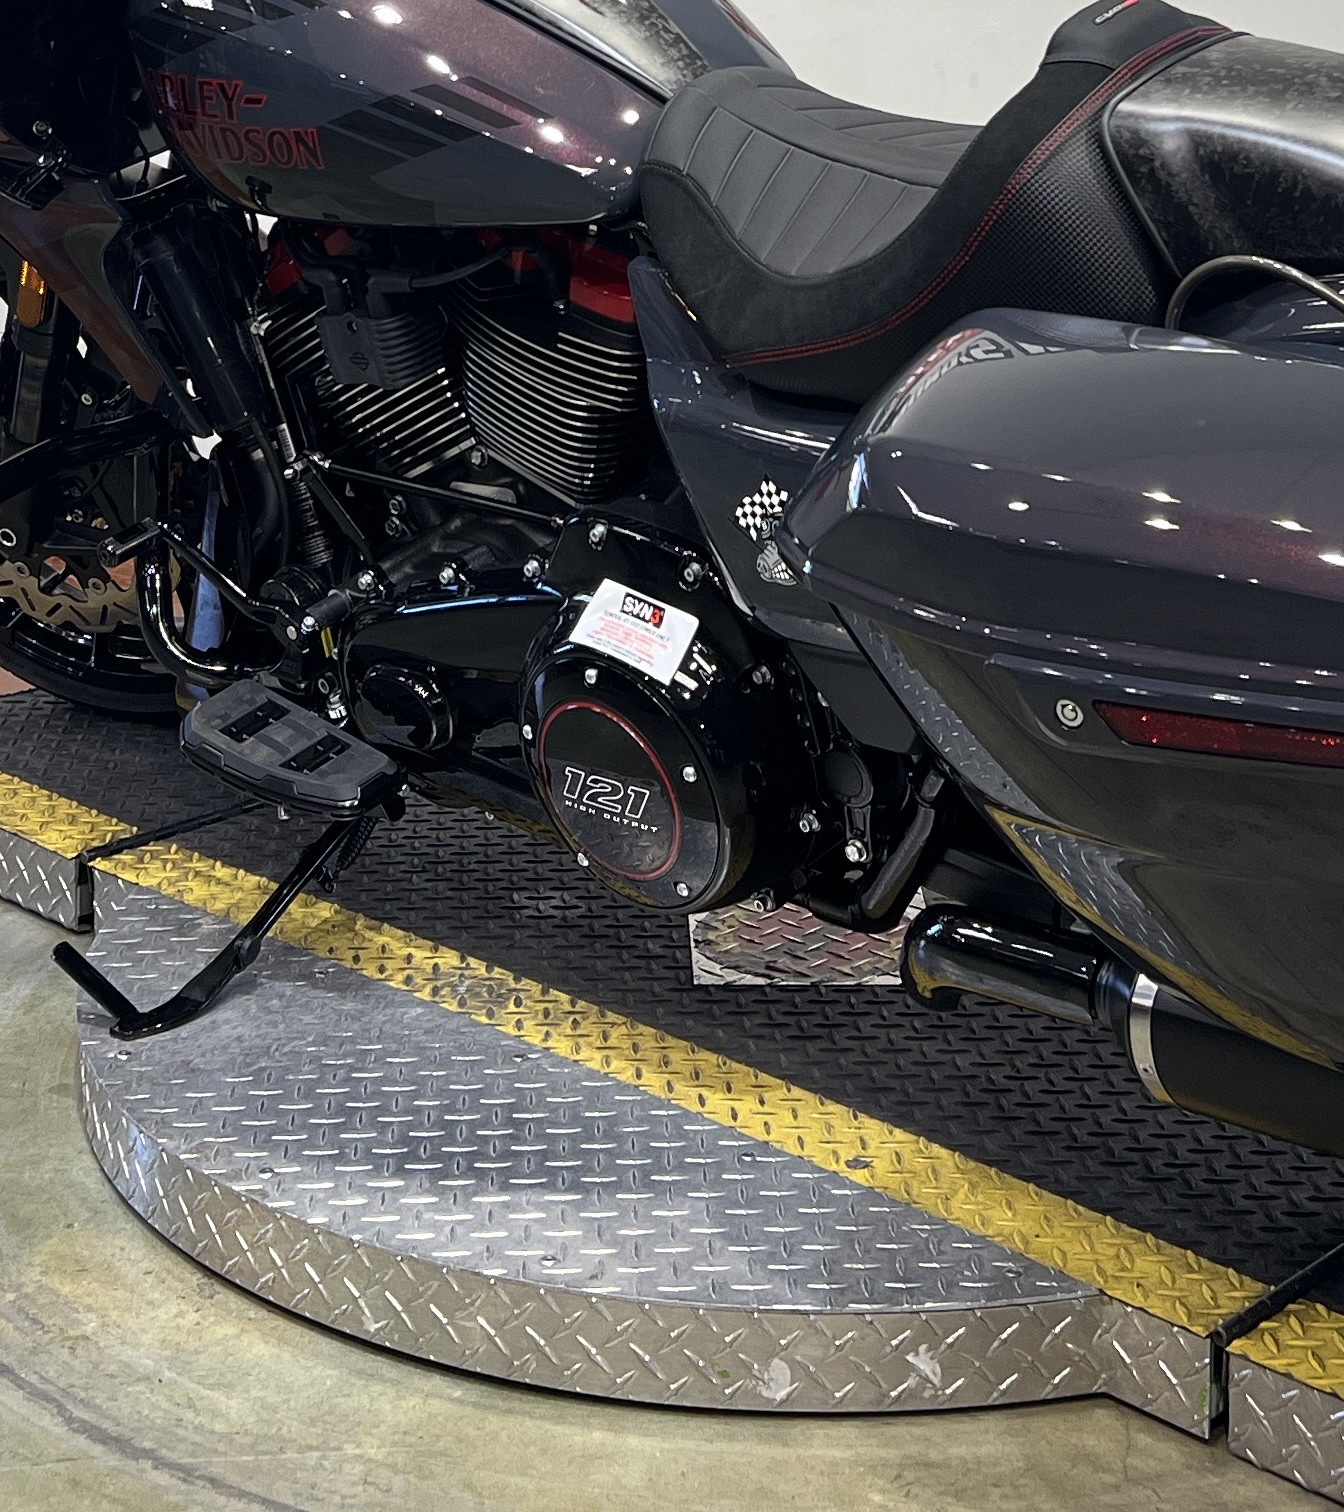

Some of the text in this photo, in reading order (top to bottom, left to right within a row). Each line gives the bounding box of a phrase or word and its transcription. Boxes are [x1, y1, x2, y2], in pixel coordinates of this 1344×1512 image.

[563, 766, 650, 819] 121
[564, 799, 658, 833] HIGH OUTPUT
